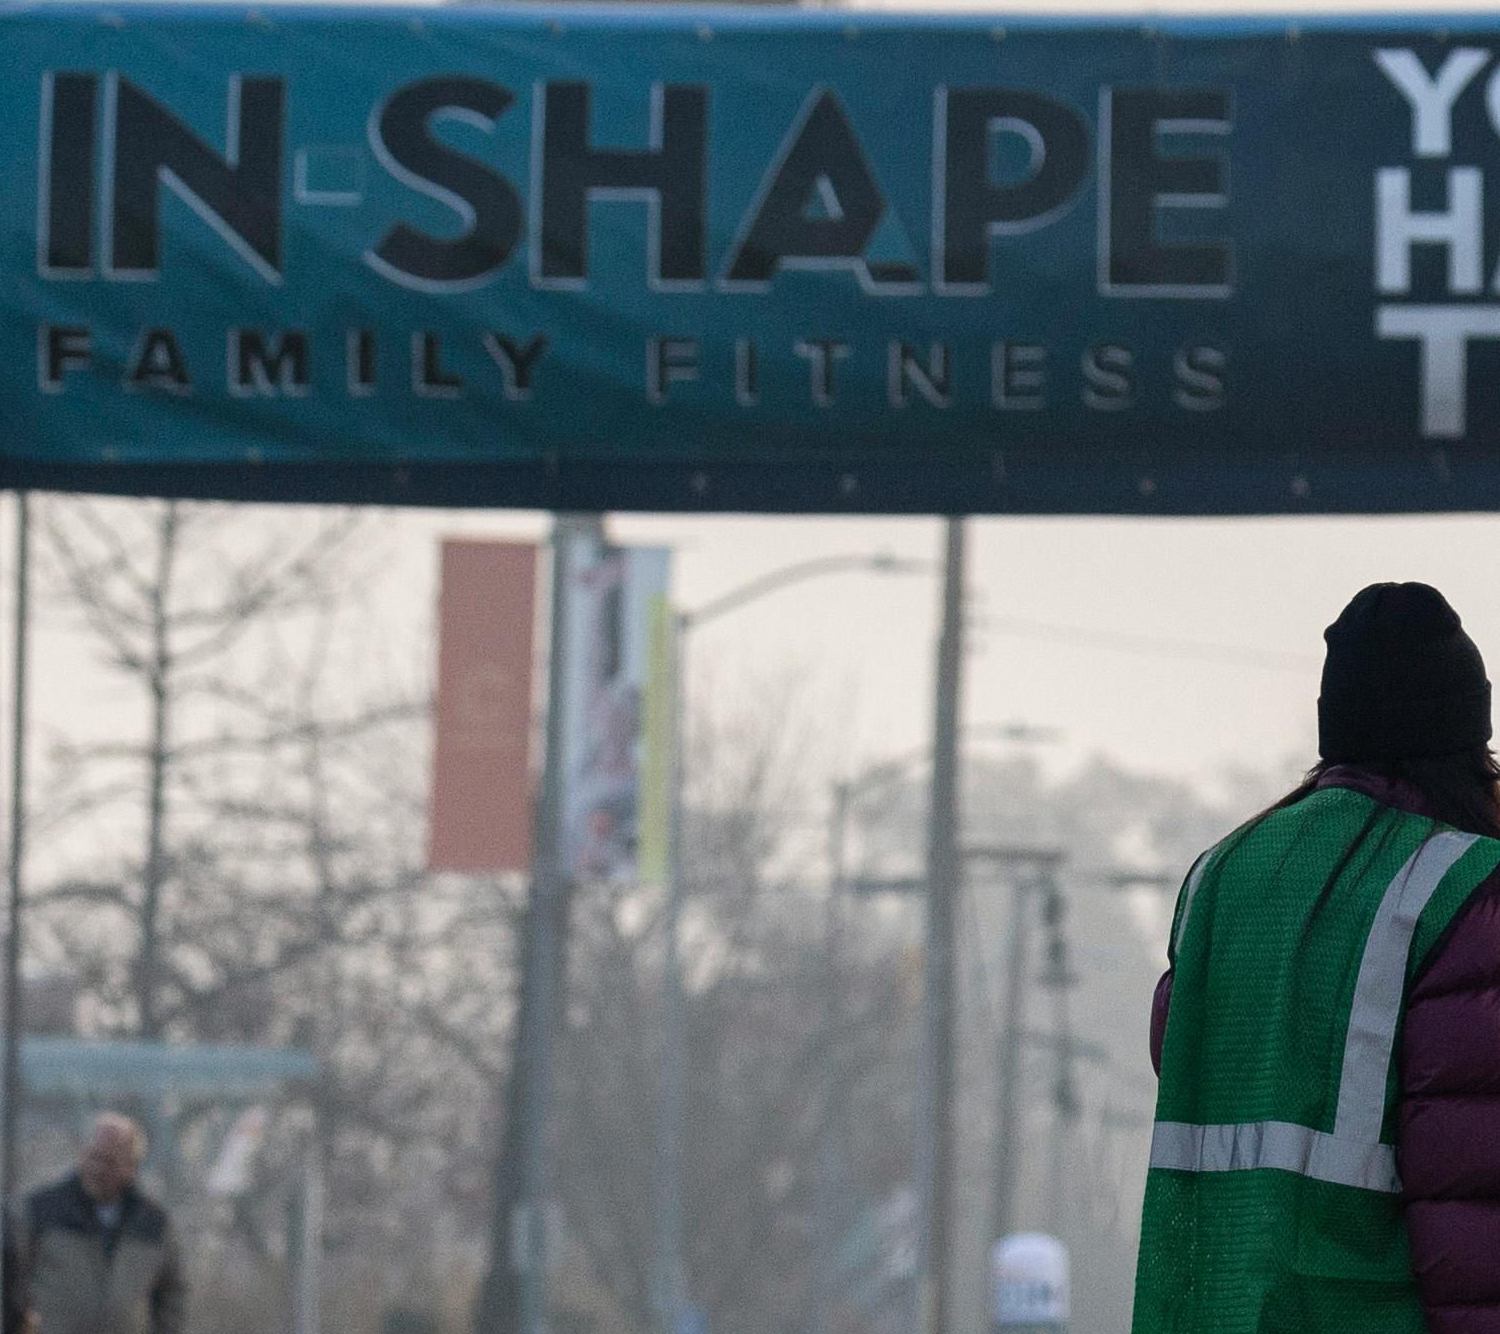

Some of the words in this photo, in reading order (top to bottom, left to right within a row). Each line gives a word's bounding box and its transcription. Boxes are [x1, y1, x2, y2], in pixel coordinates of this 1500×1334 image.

[37, 69, 1236, 299] IN-SHAPE
[37, 321, 550, 404] FAMILY
[645, 337, 1230, 412] FITNESS
